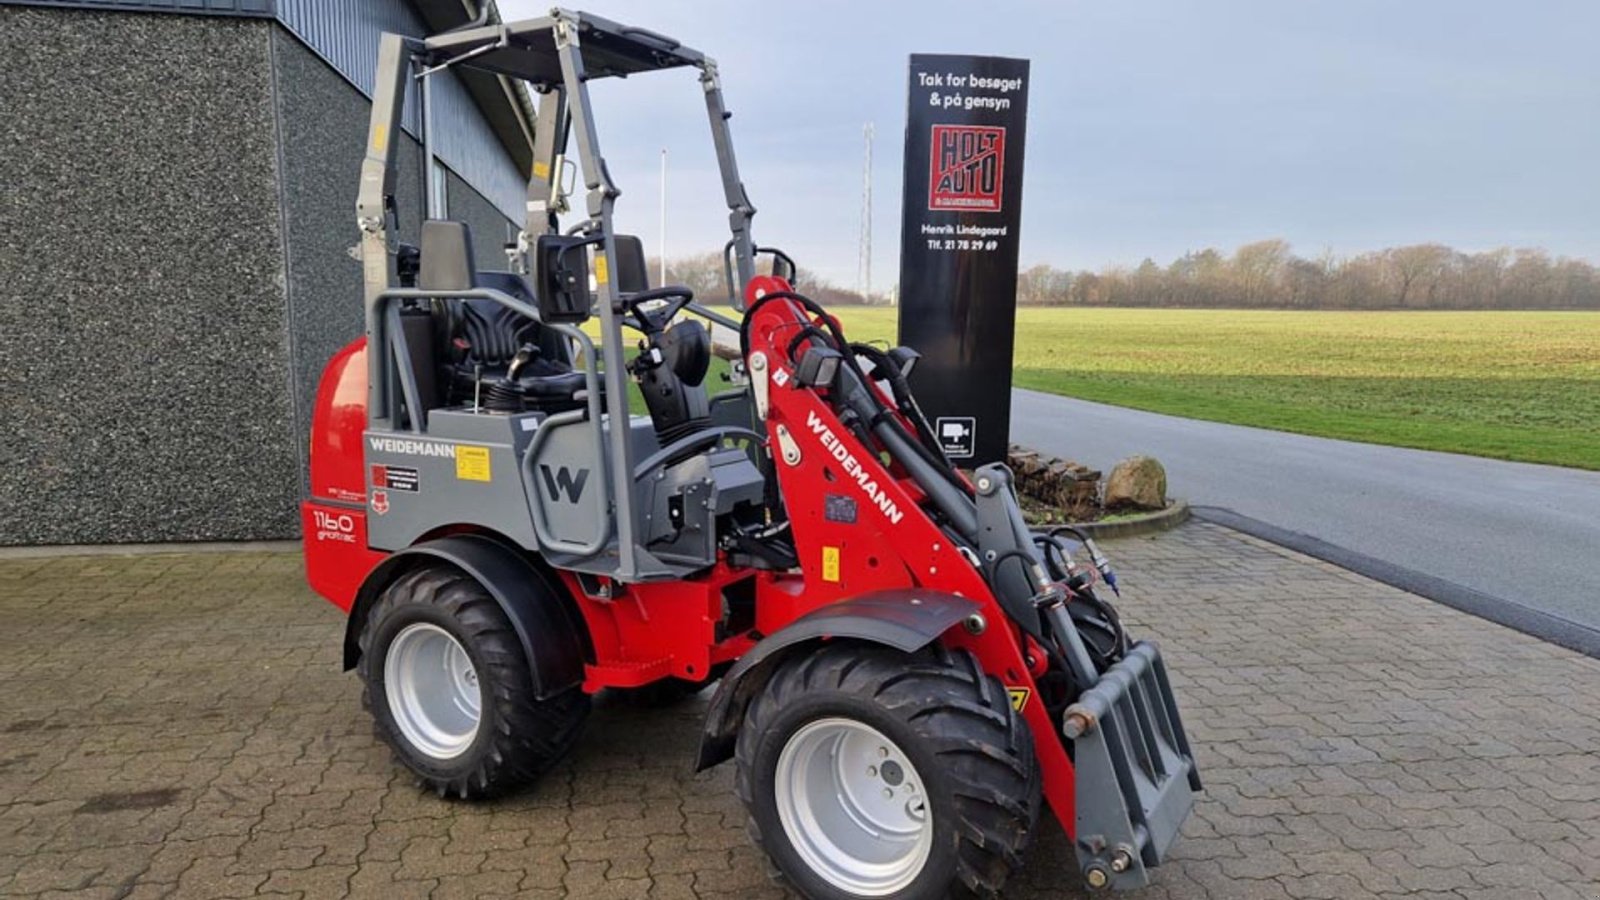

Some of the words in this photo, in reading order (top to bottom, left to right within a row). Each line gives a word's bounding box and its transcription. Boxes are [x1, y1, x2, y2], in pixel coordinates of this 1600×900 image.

[918, 72, 943, 87] Tak
[946, 73, 967, 87] for
[969, 74, 1022, 92] besøget
[929, 92, 941, 106] &
[943, 93, 962, 110] på
[964, 95, 1010, 111] gensyn
[940, 130, 1000, 175] HOLT
[935, 150, 997, 195] AUTO
[921, 224, 954, 235] Henrik
[956, 224, 1007, 237] Lindegaard
[945, 240, 955, 250] 21
[370, 437, 456, 458] WEIDEMANN
[806, 410, 904, 525] WEIDEMANN
[313, 510, 353, 532] 1160
